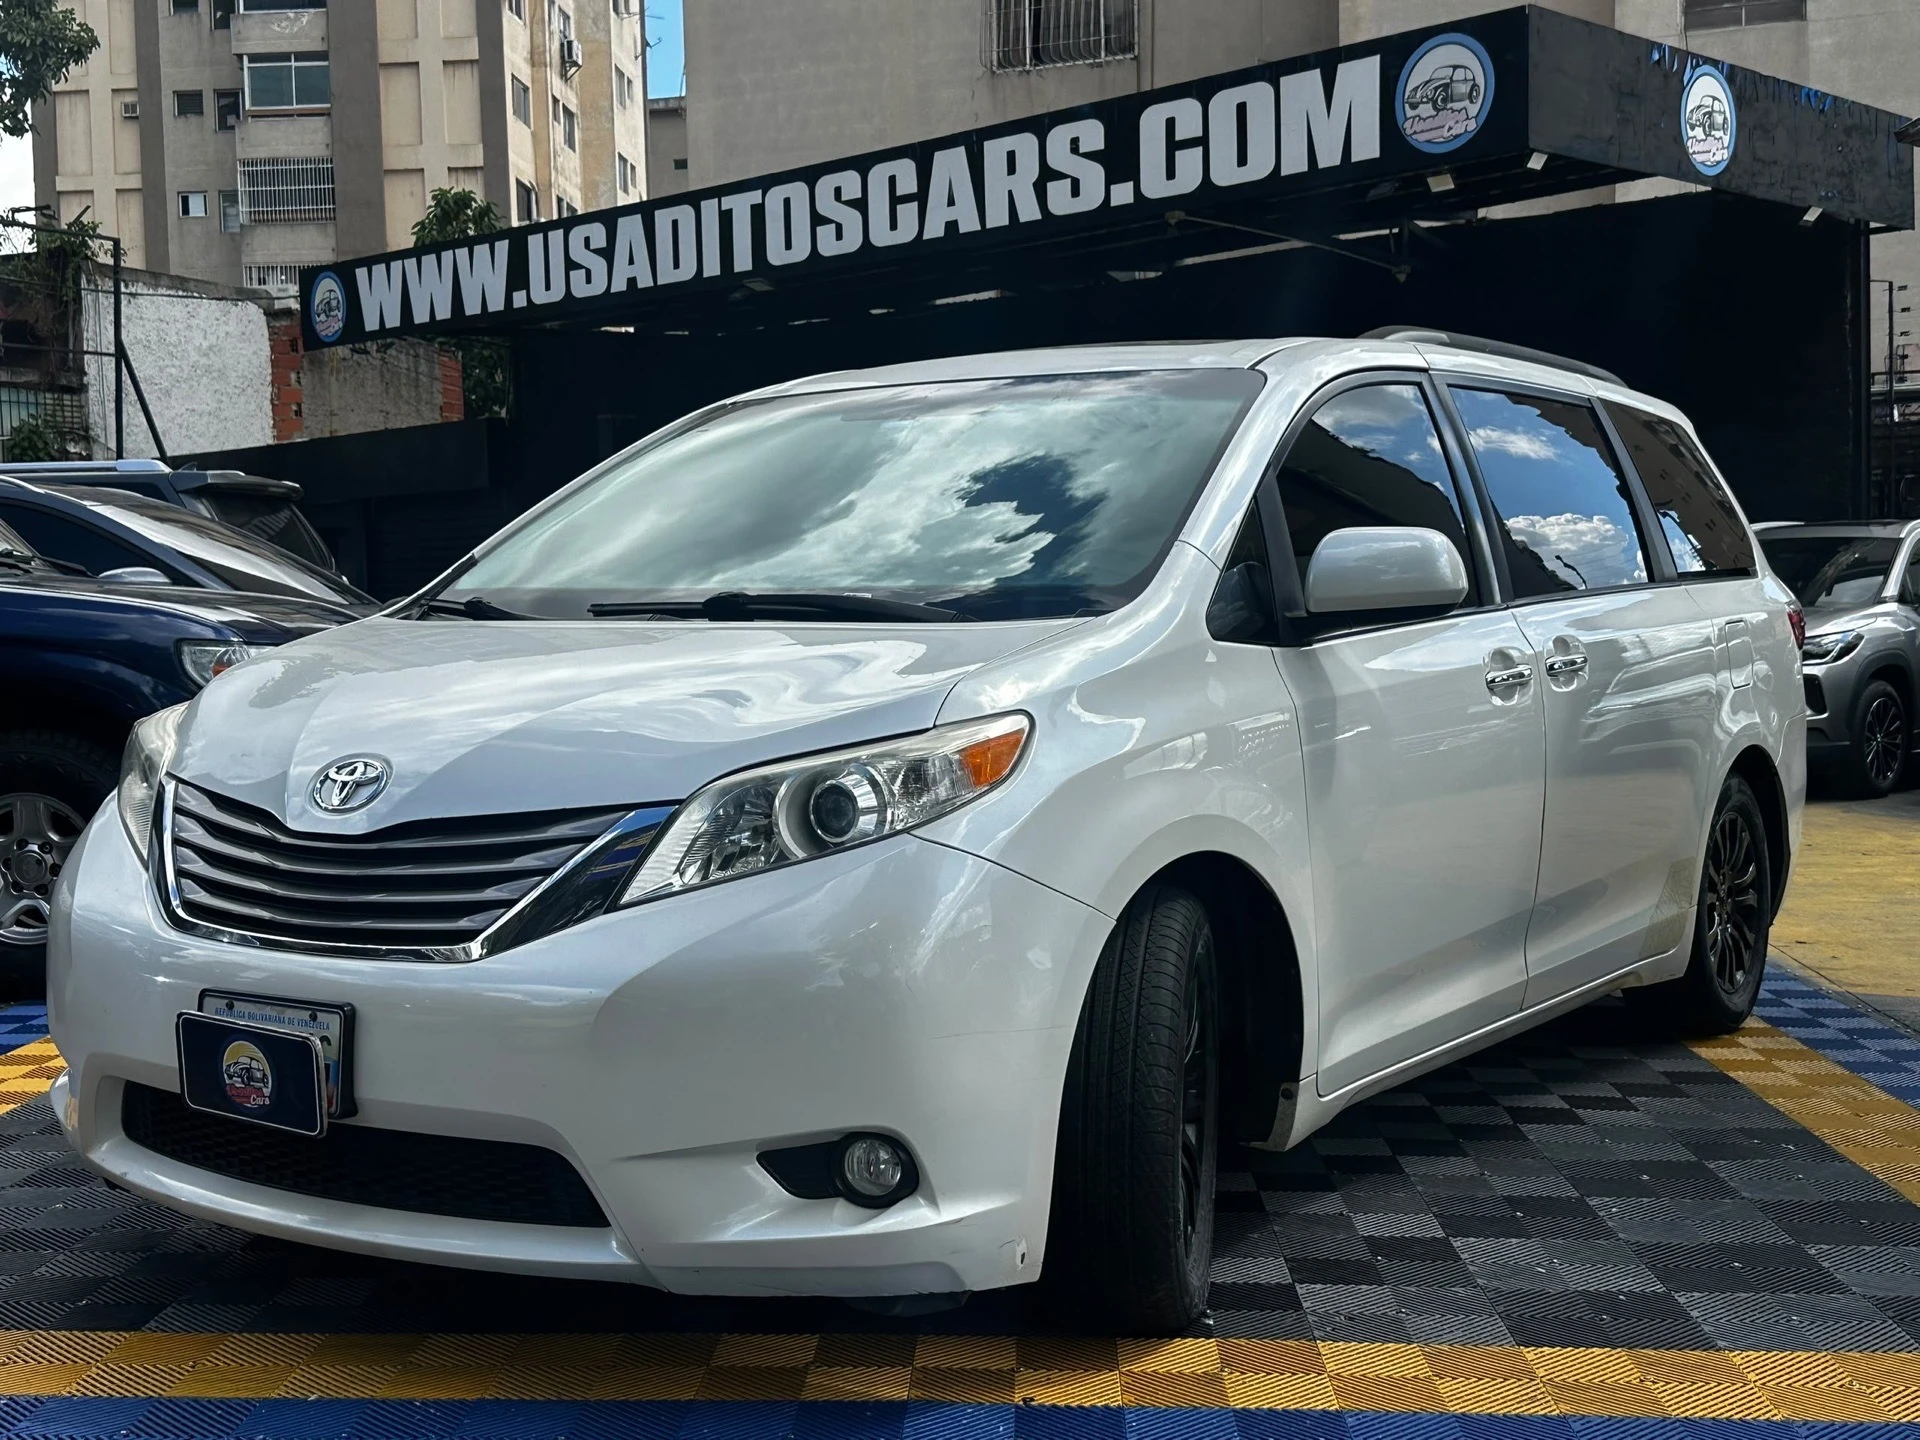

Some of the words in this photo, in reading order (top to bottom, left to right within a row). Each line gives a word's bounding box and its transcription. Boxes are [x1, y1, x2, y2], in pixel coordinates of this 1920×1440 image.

[355, 54, 1381, 332] WWW.USADITOSCARS.COM
[247, 1011, 286, 1025] BOLIVARIANA
[287, 1016, 296, 1026] DE
[297, 1018, 330, 1031] VENEZUELA
